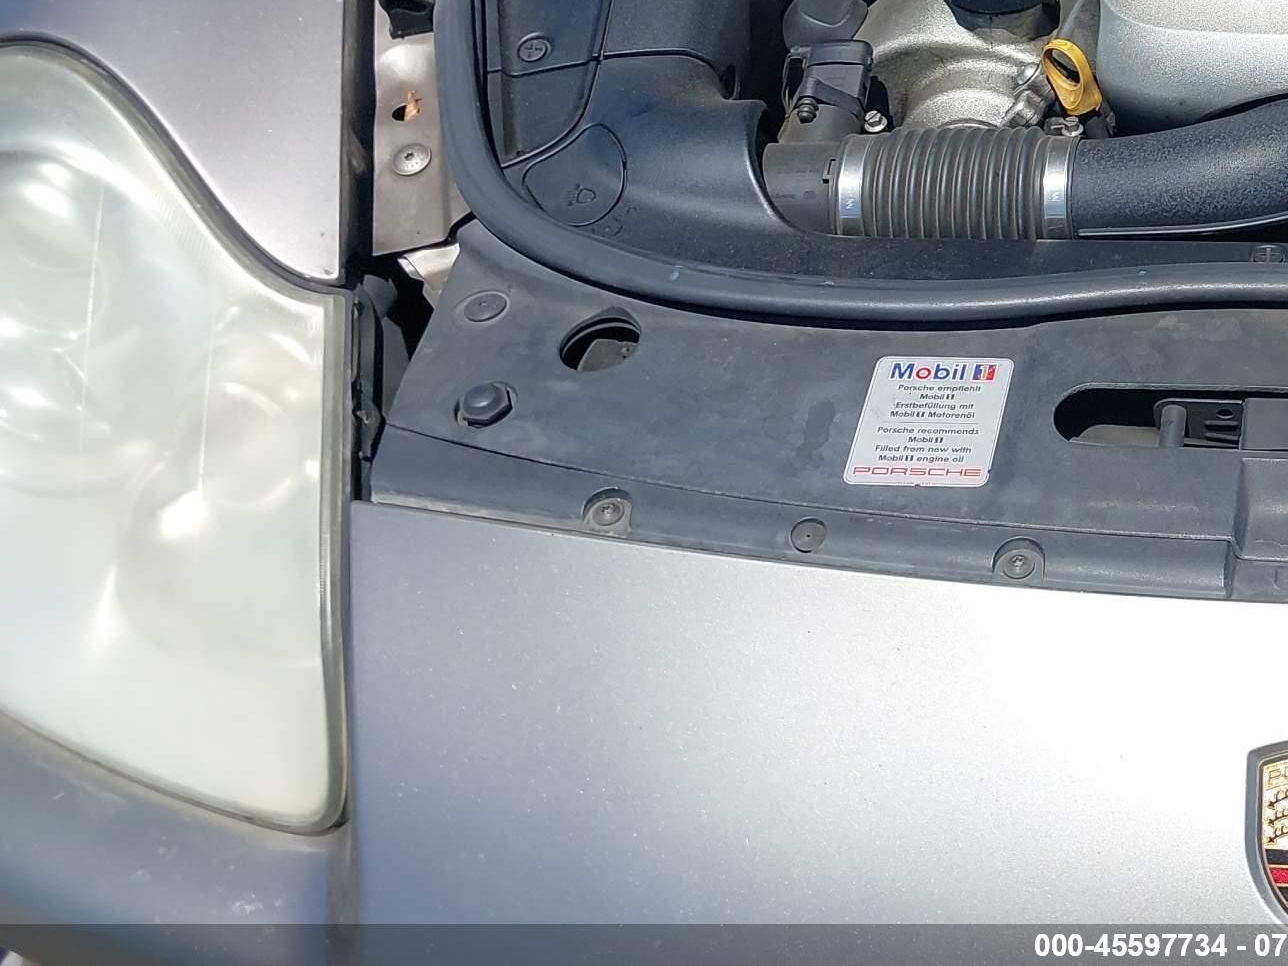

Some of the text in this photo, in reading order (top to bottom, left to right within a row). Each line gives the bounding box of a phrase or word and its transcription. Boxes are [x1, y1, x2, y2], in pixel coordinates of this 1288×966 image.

[890, 363, 966, 380] Mobil
[898, 384, 934, 392] Porsche
[952, 446, 971, 454] with
[878, 454, 903, 462] Mobil
[916, 456, 949, 464] engine
[853, 467, 981, 477] PORSCHE
